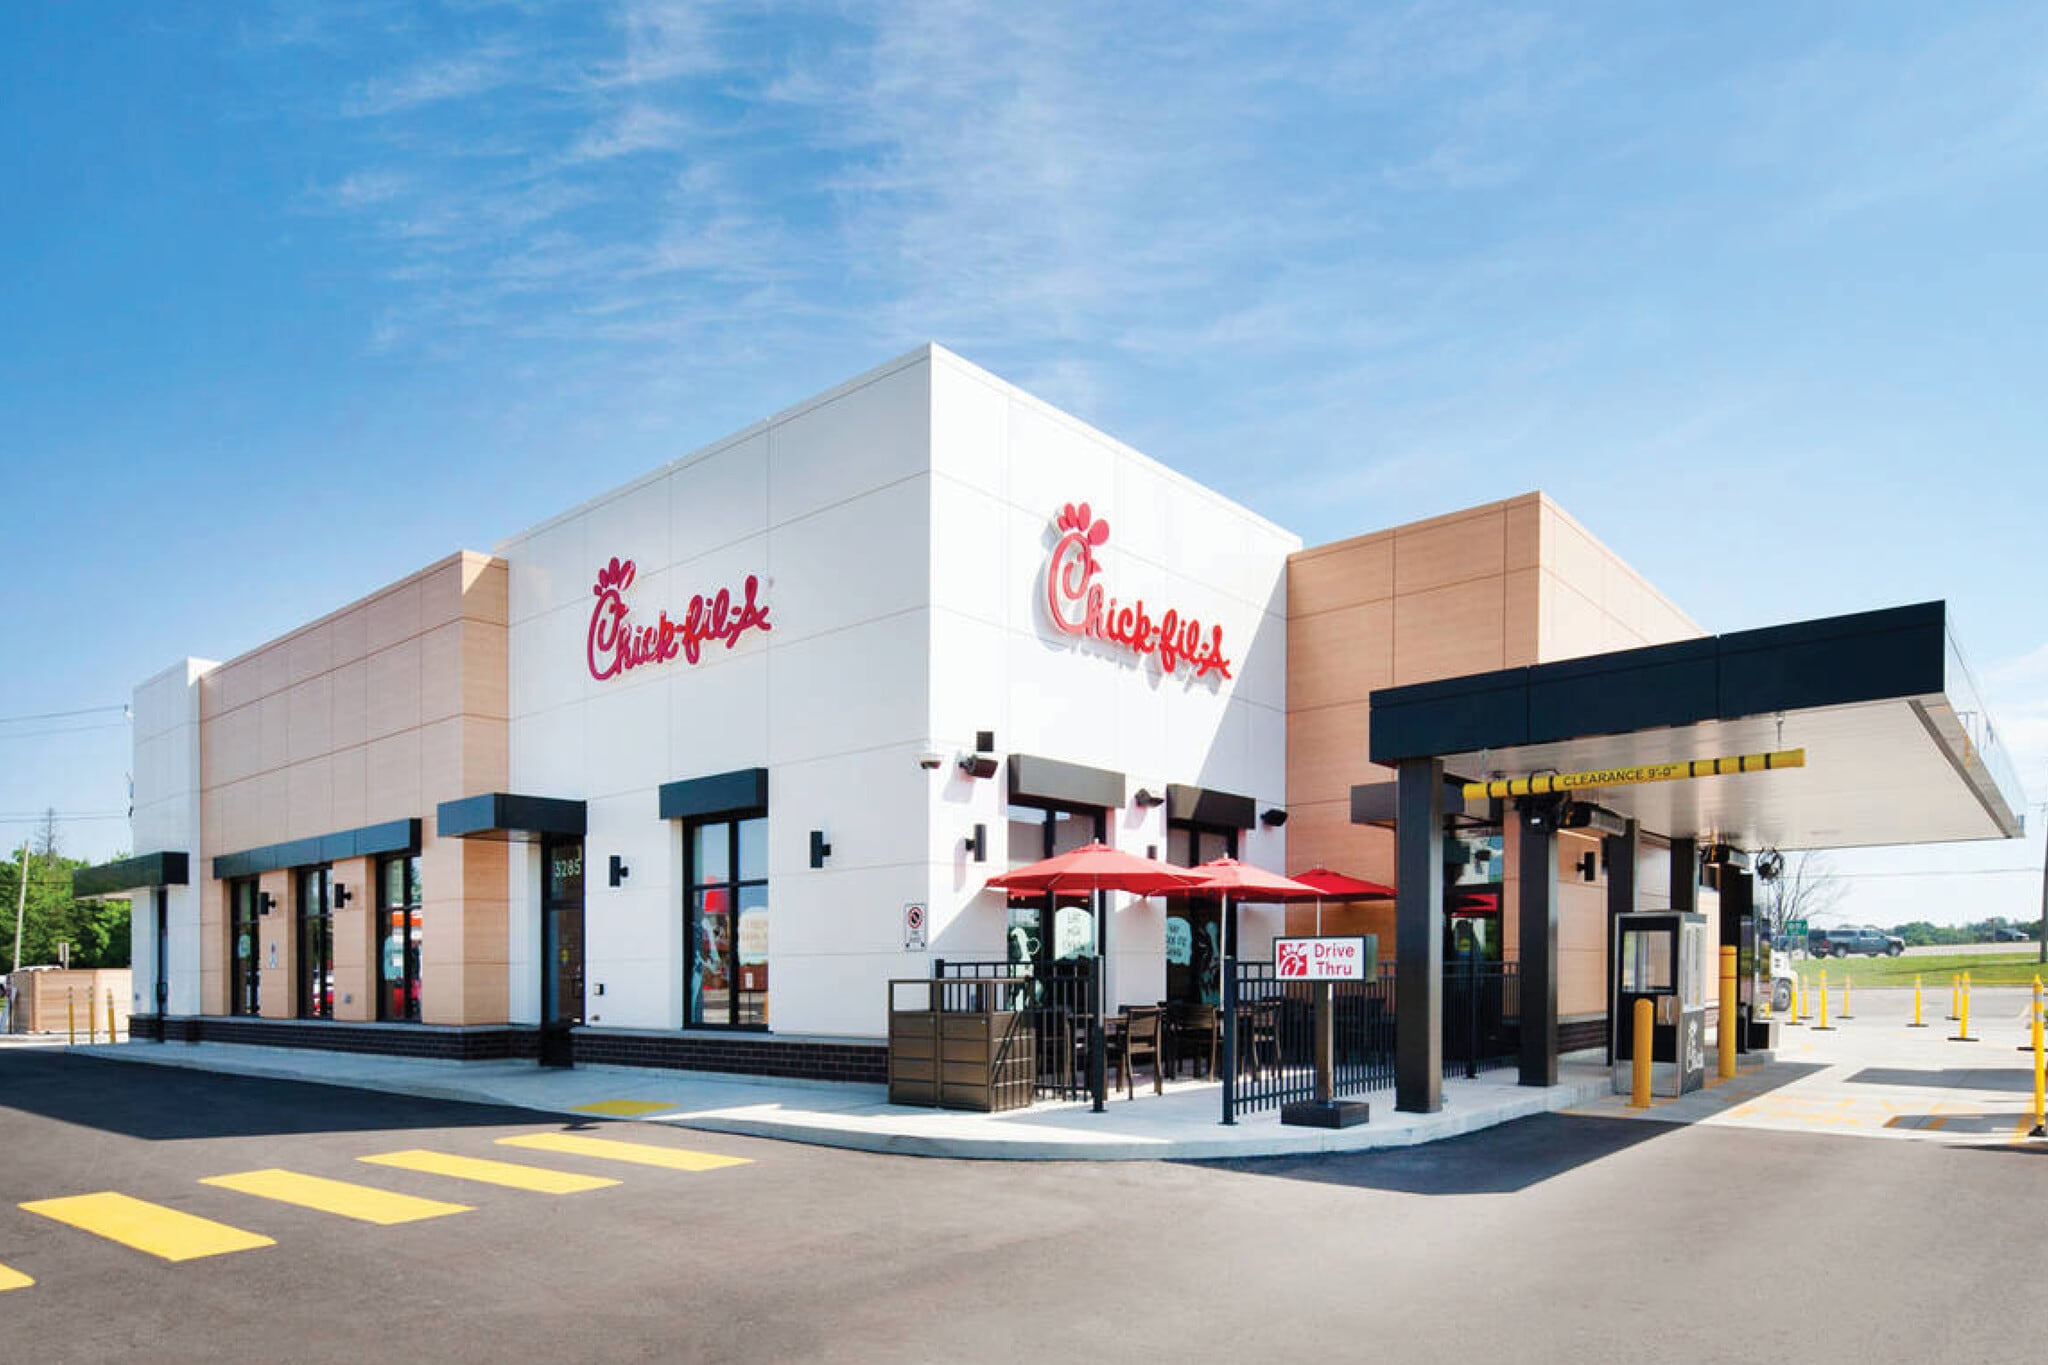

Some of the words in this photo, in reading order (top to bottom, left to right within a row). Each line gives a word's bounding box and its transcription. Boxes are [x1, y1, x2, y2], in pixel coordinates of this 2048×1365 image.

[1048, 502, 1232, 680] Chick-fil-A
[587, 557, 772, 681] Chick-fil-A
[1564, 769, 1644, 786] CLEARANCE
[554, 859, 581, 877] 3285
[1315, 942, 1355, 958] Drive
[1316, 961, 1352, 976] Thru
